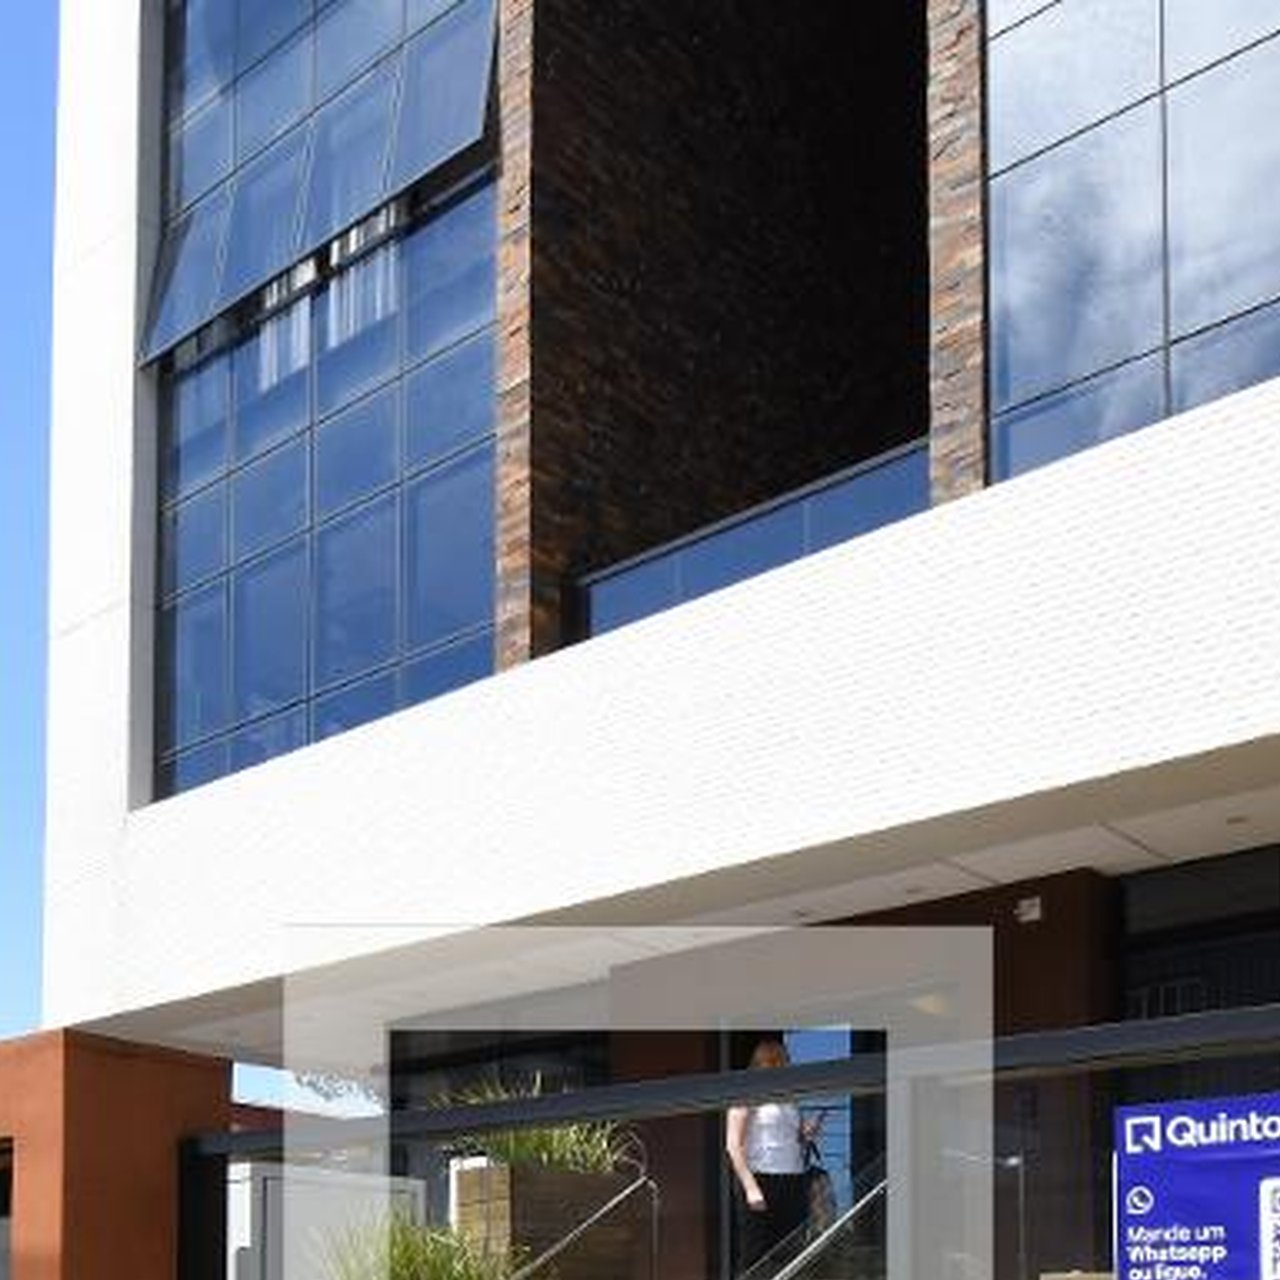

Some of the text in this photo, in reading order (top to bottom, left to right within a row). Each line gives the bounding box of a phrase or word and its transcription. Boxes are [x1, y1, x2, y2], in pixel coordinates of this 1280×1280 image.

[1128, 1224, 1224, 1242] Mande um
[1129, 1268, 1151, 1280] ou
